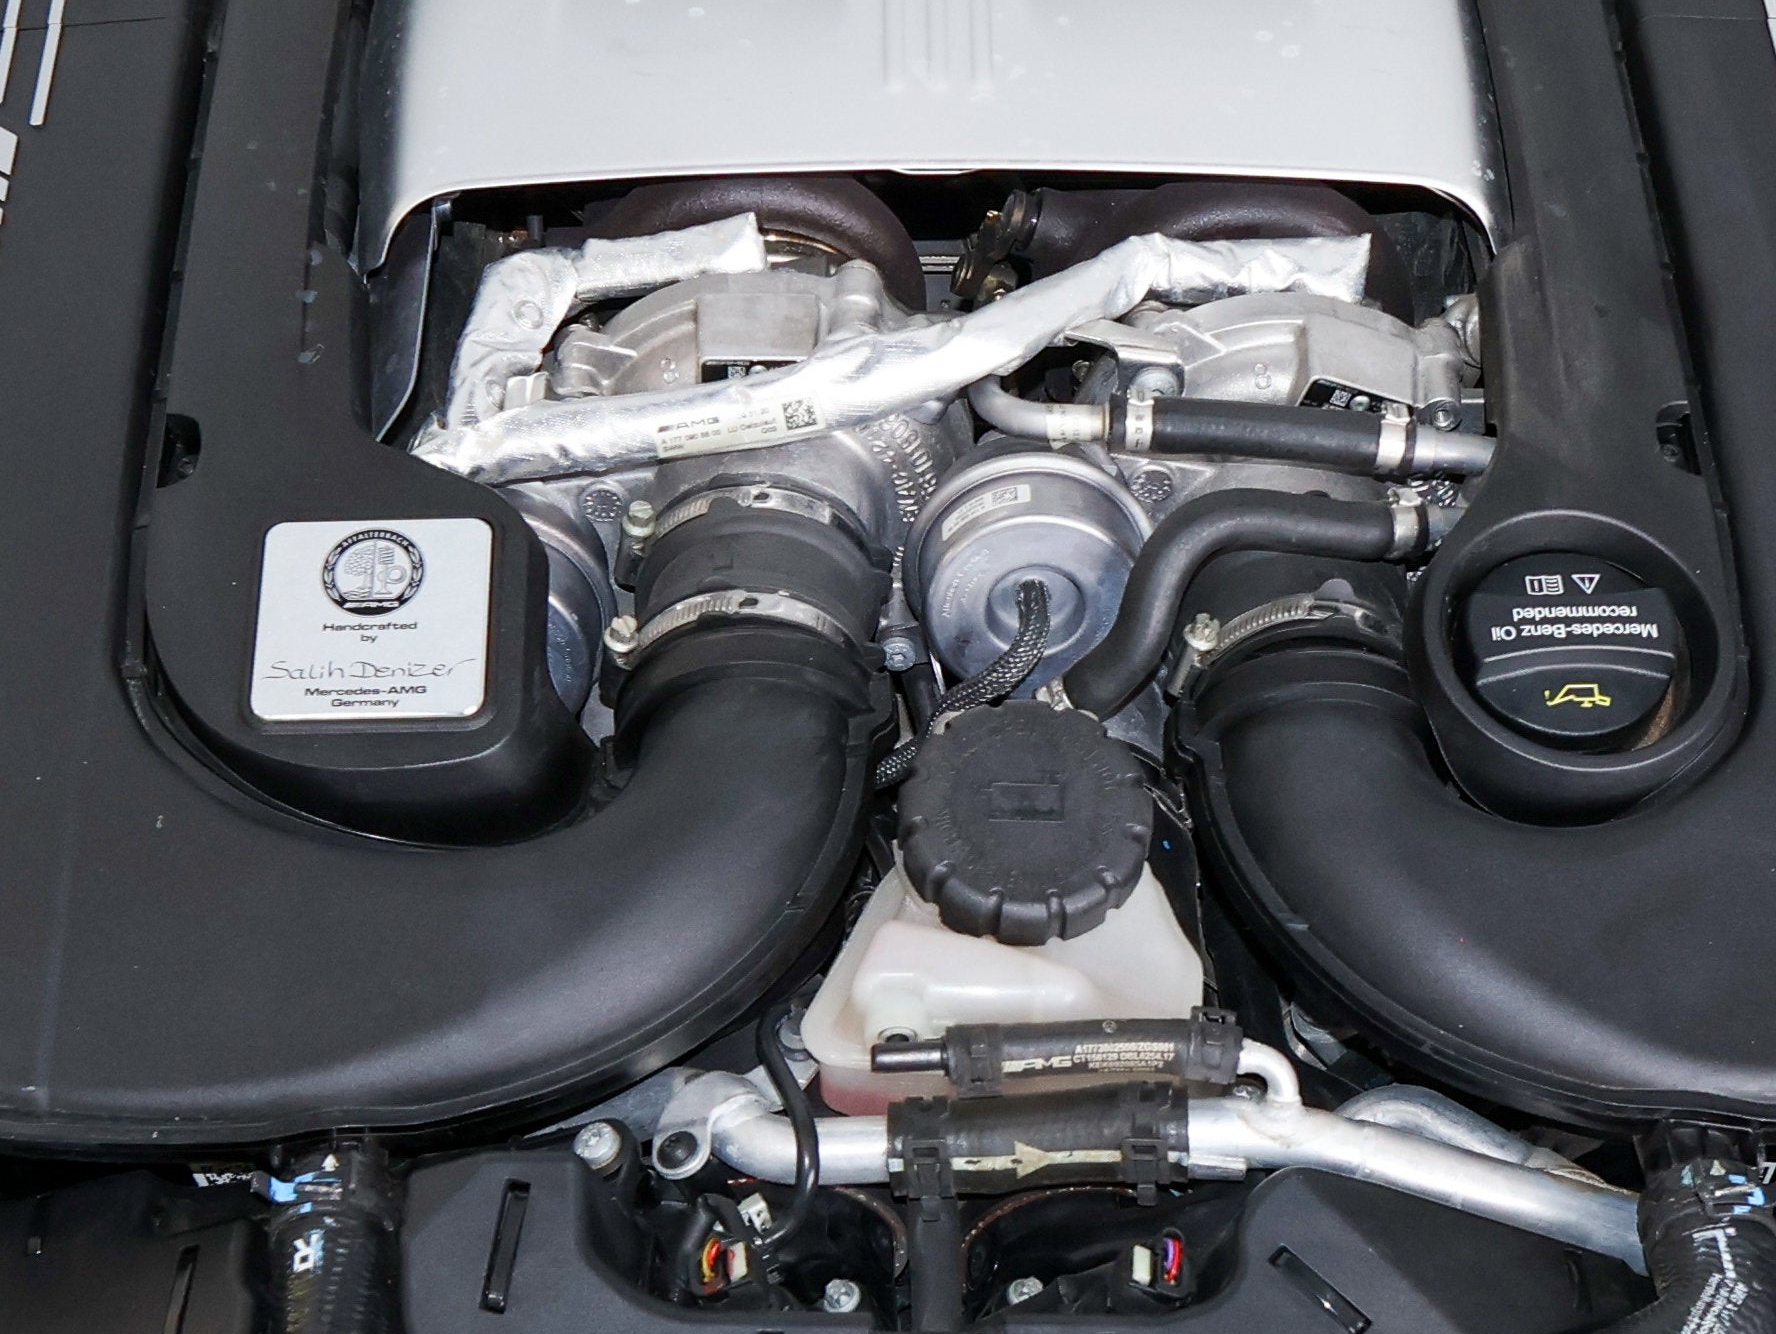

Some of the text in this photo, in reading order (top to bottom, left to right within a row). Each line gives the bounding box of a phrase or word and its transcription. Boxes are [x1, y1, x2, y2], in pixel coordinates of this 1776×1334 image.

[1512, 605, 1638, 622] recommended
[322, 621, 418, 632] Handcrafted
[1491, 622, 1659, 642] Mercedes-Benz Oil
[360, 633, 378, 644] by
[304, 685, 428, 697] Mercedes-AMG
[331, 697, 401, 709] Germany
